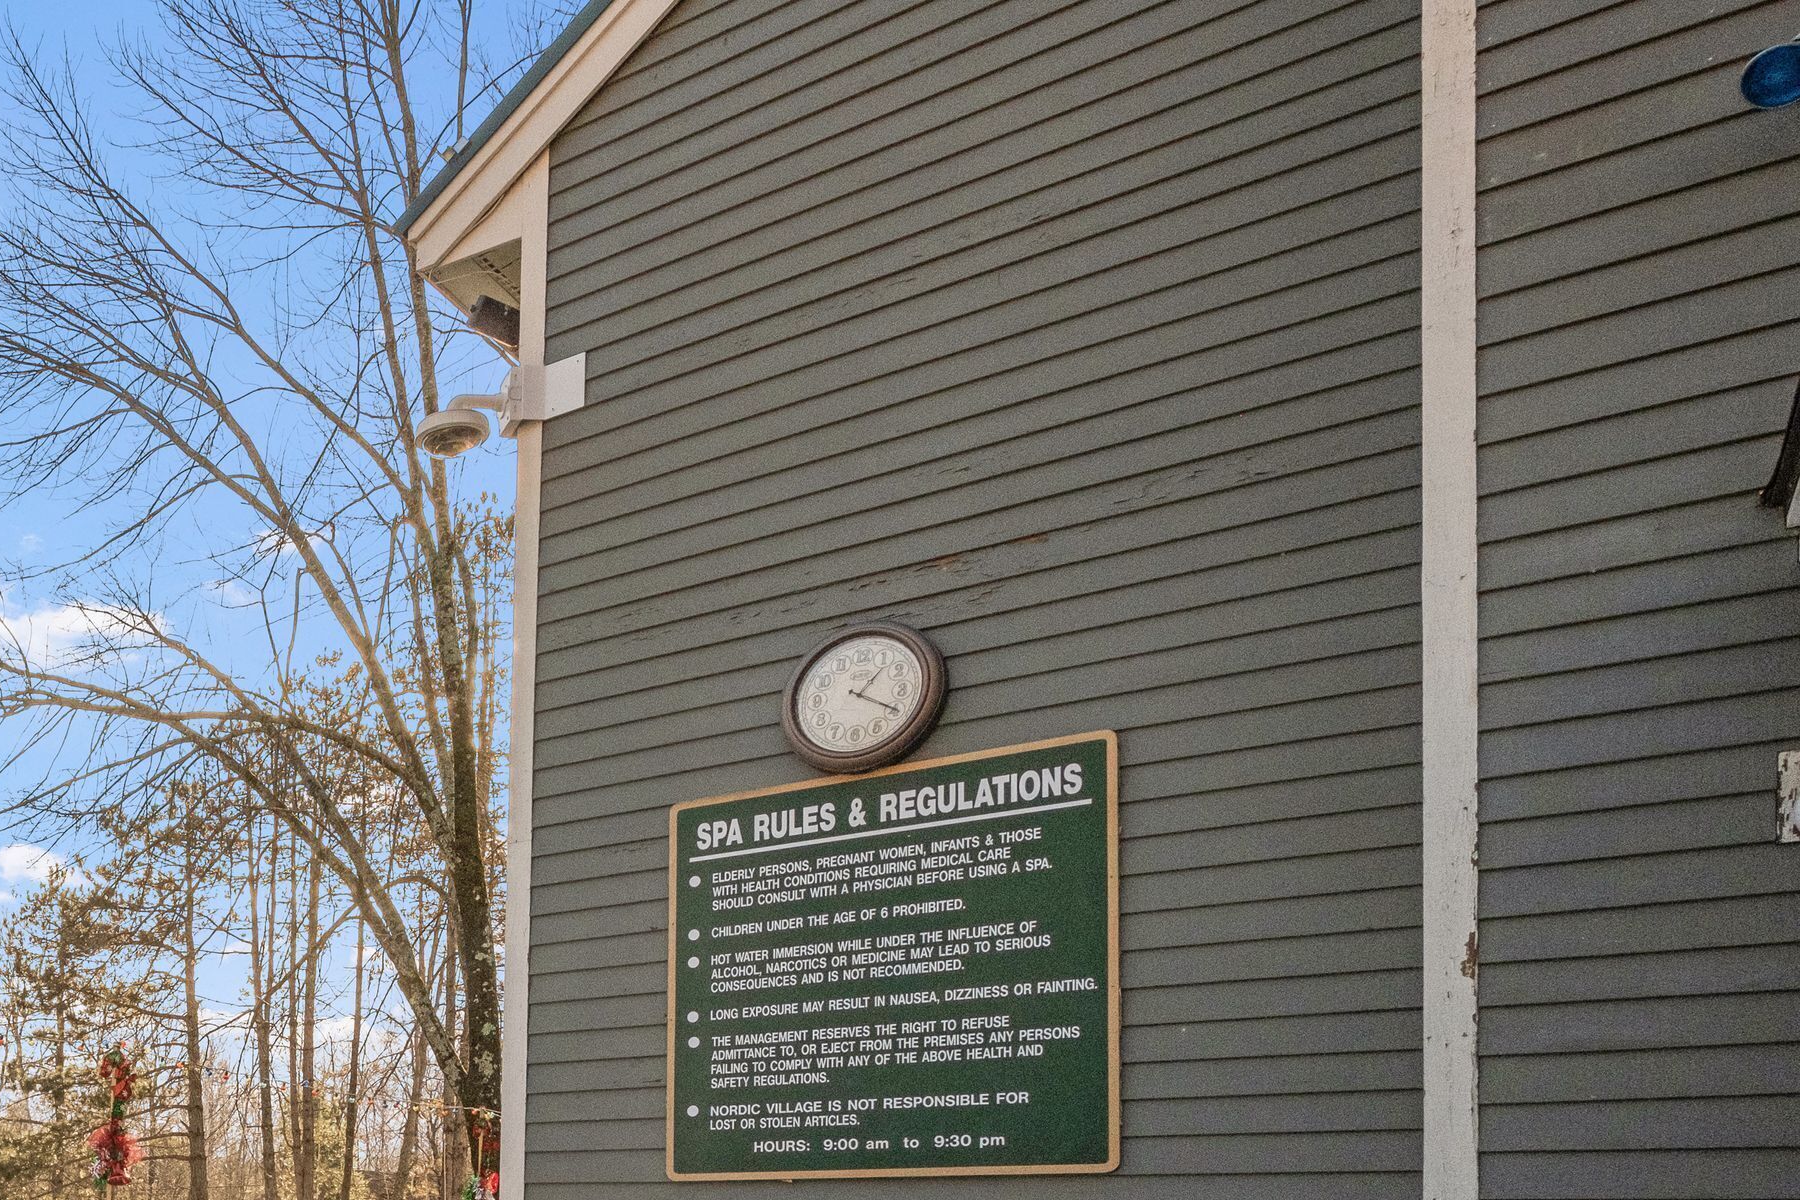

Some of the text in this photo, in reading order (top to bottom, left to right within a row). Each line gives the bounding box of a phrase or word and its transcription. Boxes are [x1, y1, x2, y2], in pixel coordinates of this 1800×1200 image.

[856, 649, 871, 663] 12
[881, 652, 887, 665] 1
[836, 658, 846, 671] 11
[893, 663, 904, 678] 2
[821, 673, 832, 688] 10
[897, 682, 908, 697] 3
[812, 694, 822, 708] 9
[816, 713, 825, 726] 8
[872, 720, 883, 734] 5
[830, 725, 839, 739] 7
[850, 728, 860, 741] 6
[696, 763, 1082, 849] SPA RULES & REGULATIONS
[712, 828, 1041, 883] ELDERLY PERSONS, PREGNANT WOMEN, INFANTS & THOSE
[712, 847, 1010, 896] WITH HEALTH CONDITIONS REQUIRING MEDICAL CARE
[711, 858, 1052, 910] SHOULD CONSULT WITH A PHYSICIAN BEFORE USING A SPA.
[711, 899, 965, 937] CHILDREN UNDER THE AGE OF 6 PROHIBITED.
[710, 921, 1036, 965] HOT WATER IMMERSION WHILE UNDER THE INFLUENCE OF
[710, 935, 1050, 979] ALCOHOL, NARCOTICS OR MEDICINE MAY LEAD TO SERIOUS
[710, 959, 964, 992] CONSEQUENCES AND IS NOT RECOMMENDED.
[710, 978, 1097, 1020] LONG EXPOSURE MAY RESULT IN NAUSEA, DIZZINESS OR FAINTING.
[711, 1016, 1009, 1046] THE MANAGEMENT RESERVES THE RIGHT TO REFUSE
[711, 1026, 1079, 1060] ADMITTANCE TO, OR EJECT FROM THE PREMISES ANY PERSONS
[710, 1044, 1043, 1074] FAILING TO COMPLY WITH ANY OF THE ABOVE HEALTH AND
[710, 1073, 829, 1088] SAFETY REGULATIONS.
[709, 1092, 1028, 1116] NORDIC VILLAGE IS NOT RESPONSIBLE FOR
[709, 1115, 859, 1129] LOST OR STOLEN ARTICLES.
[753, 1136, 1004, 1152] HOURS: 9:00 am to 9:30 pm
